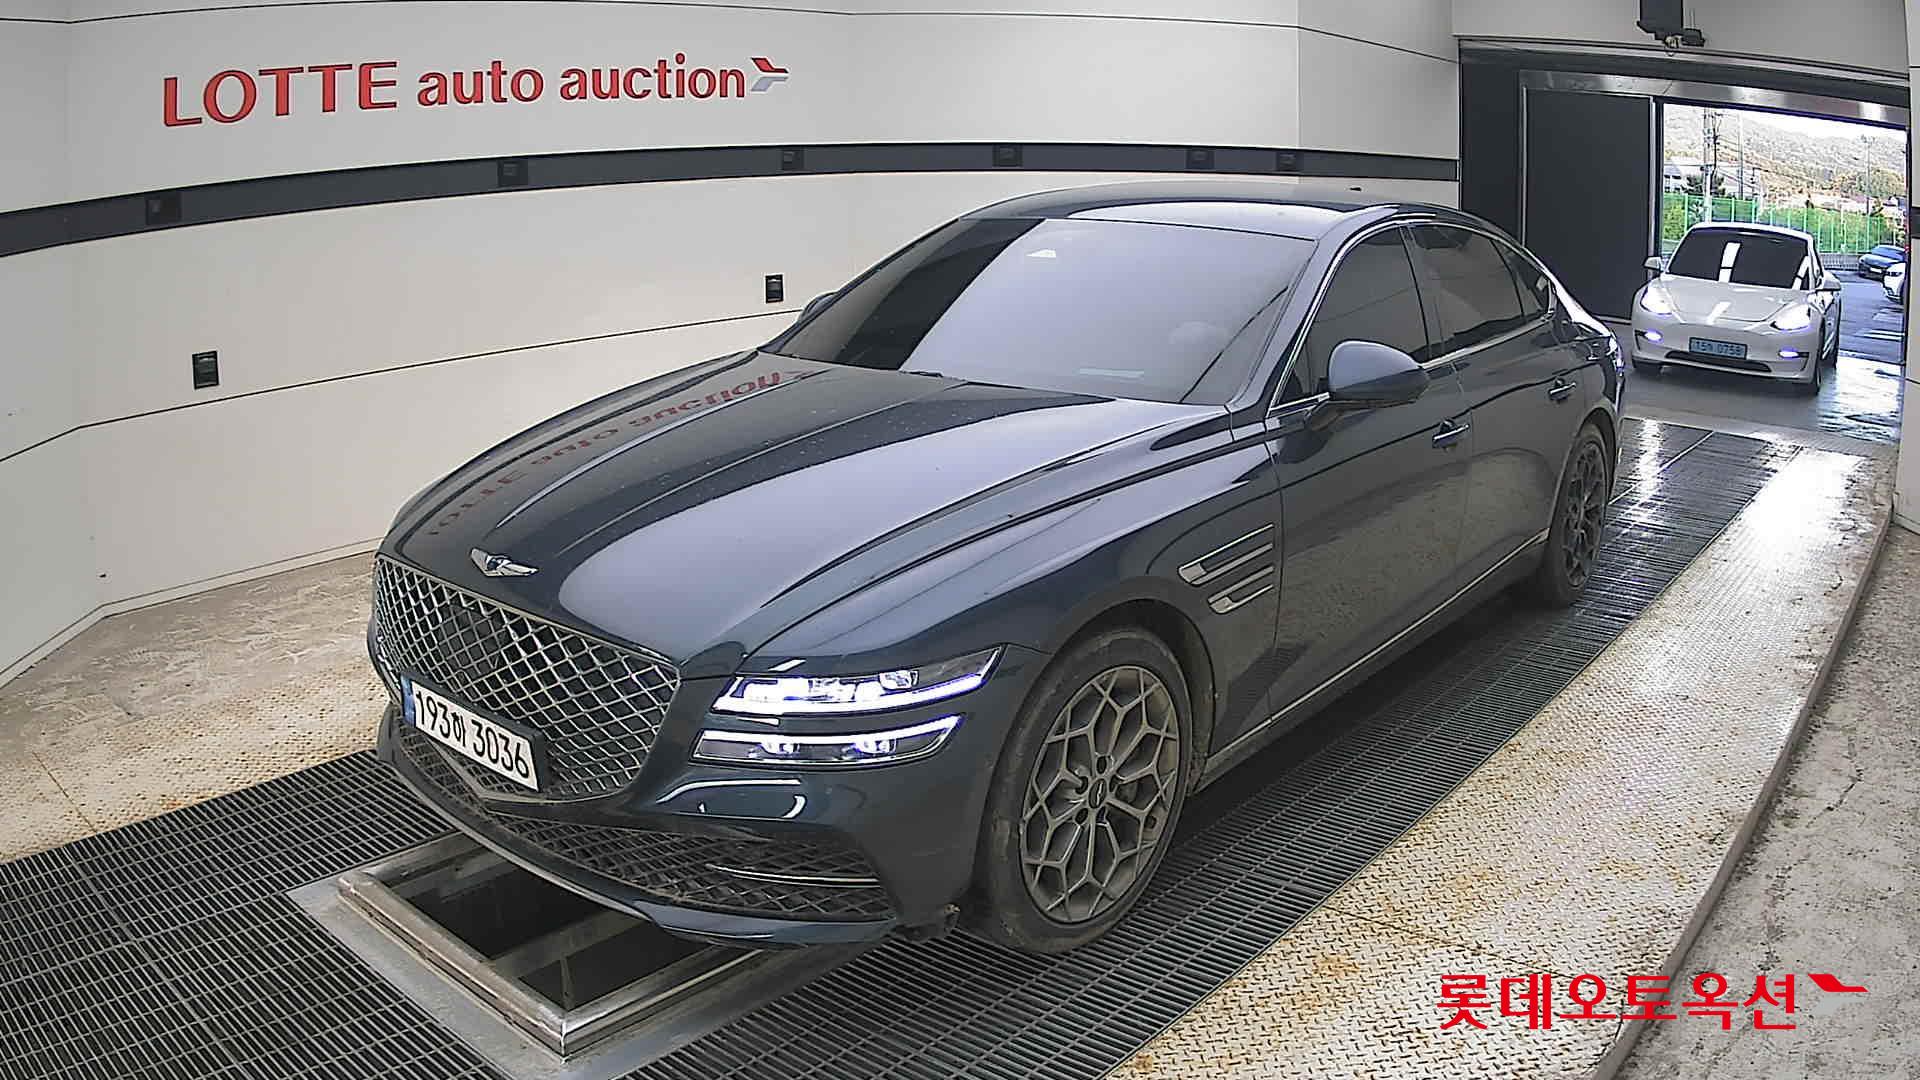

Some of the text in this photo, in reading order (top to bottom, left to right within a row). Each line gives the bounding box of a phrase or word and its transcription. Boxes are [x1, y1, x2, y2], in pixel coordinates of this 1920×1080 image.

[163, 52, 746, 127] LOTTE auto auction
[471, 719, 529, 779] 3036
